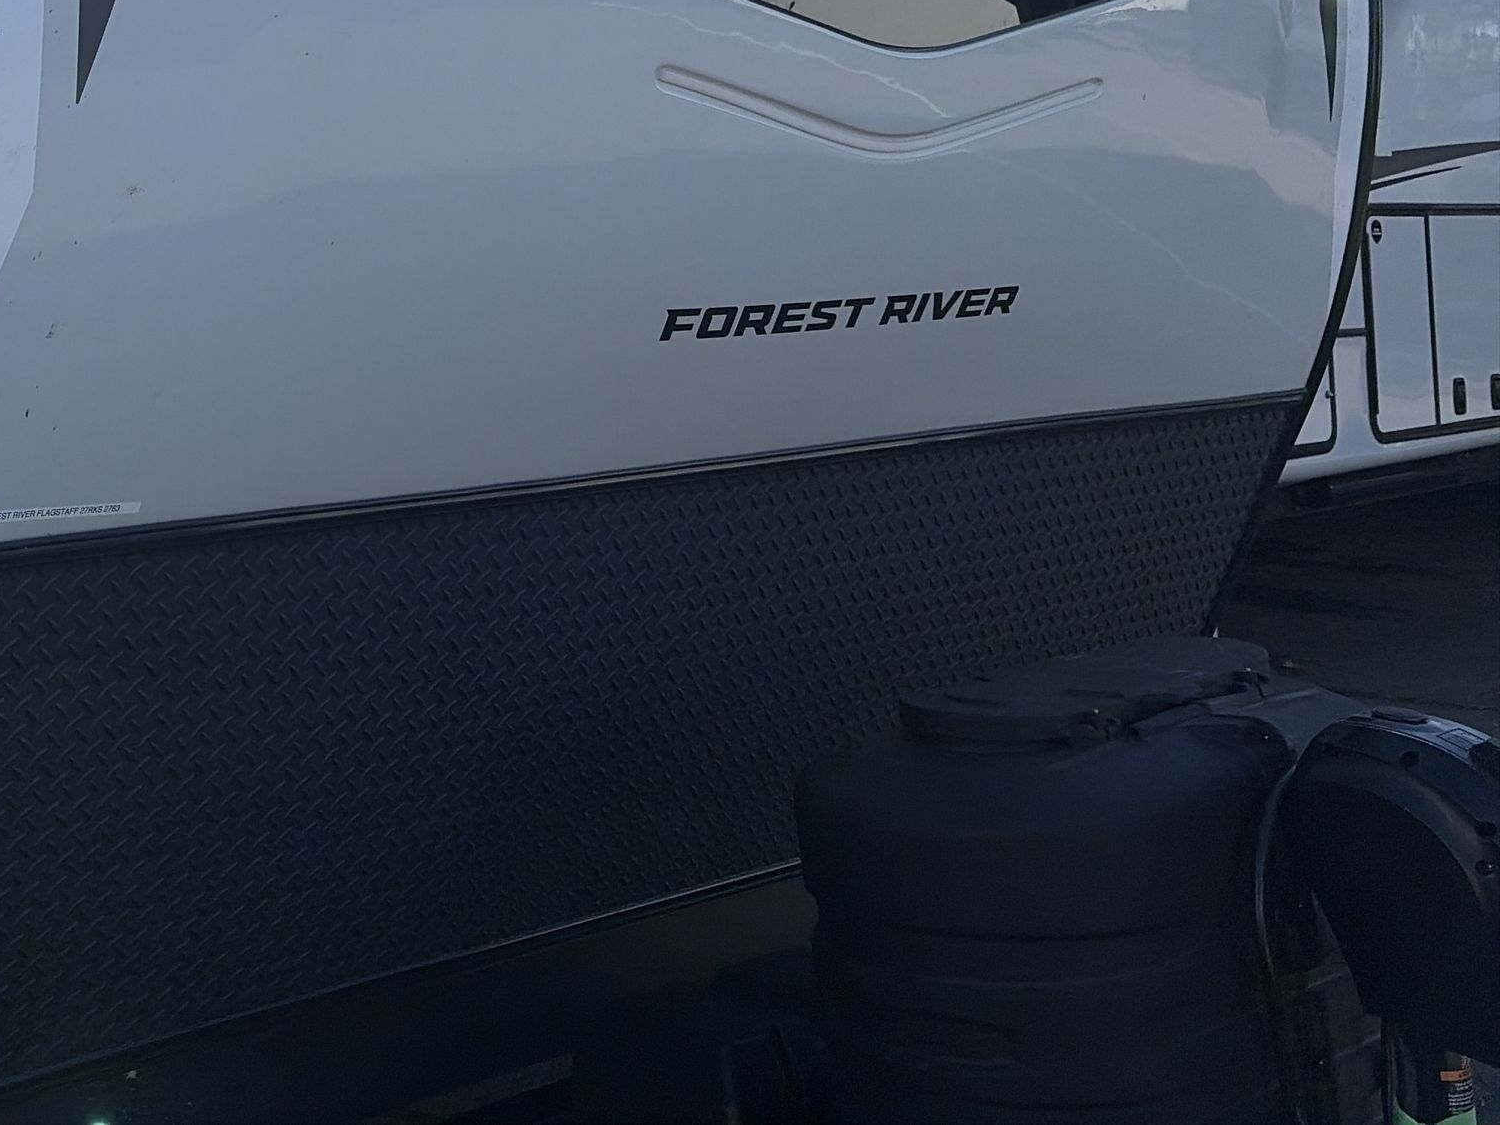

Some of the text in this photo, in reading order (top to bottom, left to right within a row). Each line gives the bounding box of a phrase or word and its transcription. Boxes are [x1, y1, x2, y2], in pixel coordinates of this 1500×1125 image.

[659, 285, 1020, 341] FOREST RIVER
[13, 510, 36, 519] RIVER
[36, 507, 79, 517] FLAGSTAFF
